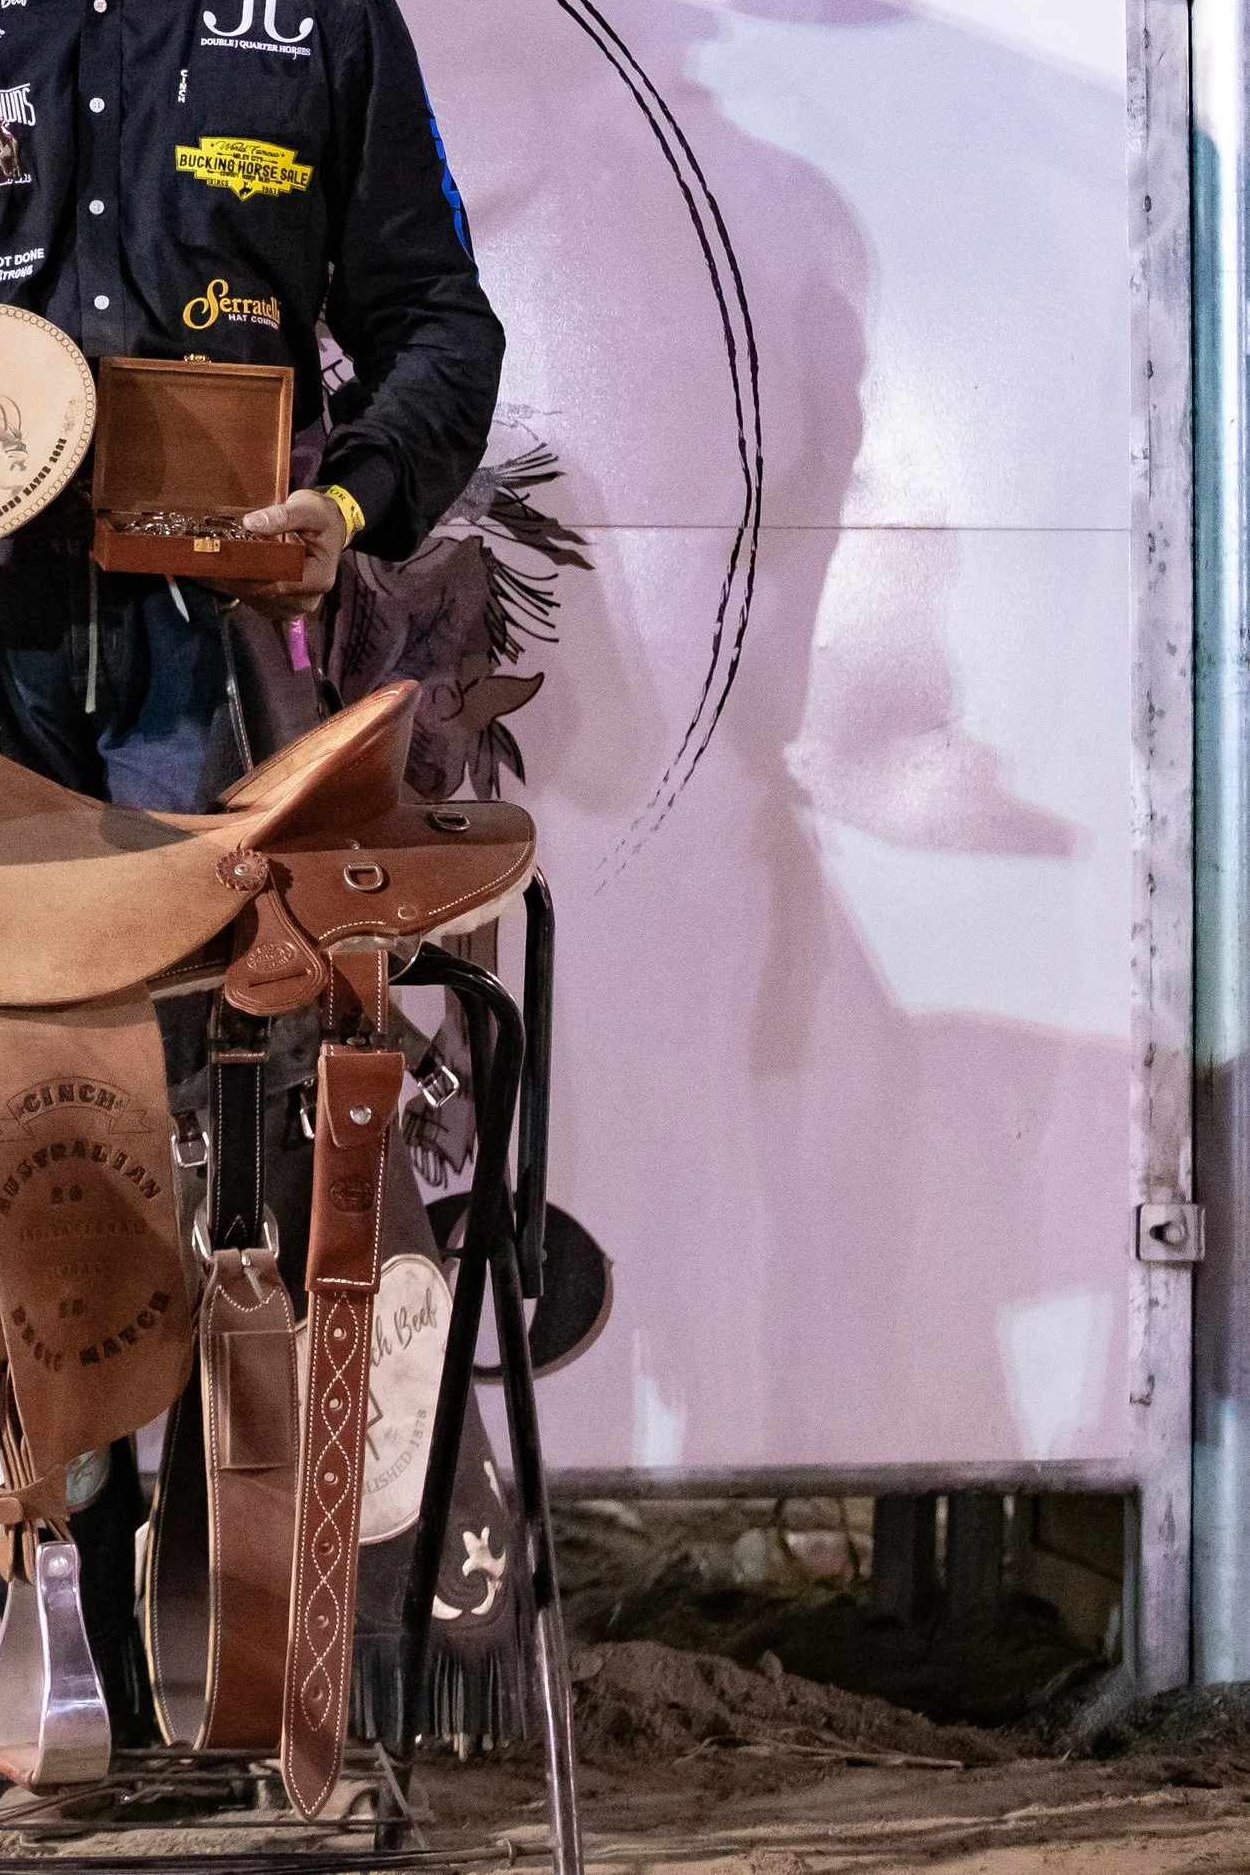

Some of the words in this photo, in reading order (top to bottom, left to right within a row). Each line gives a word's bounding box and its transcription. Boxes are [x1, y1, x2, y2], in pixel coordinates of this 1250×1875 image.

[201, 38, 234, 46] DOUBLE
[240, 40, 279, 53] QUARTER
[279, 45, 311, 60] HORSES
[177, 69, 188, 104] CINCH
[215, 140, 247, 152] World
[246, 145, 279, 158] Famous
[180, 154, 235, 172] BUCKING
[238, 160, 278, 180] HORSE
[280, 168, 308, 187] SALE
[14, 247, 45, 265] DONE
[228, 313, 248, 322] HAT
[23, 1083, 116, 1112] CINCH
[394, 1287, 437, 1350] Beef
[363, 1450, 413, 1495] LISHED
